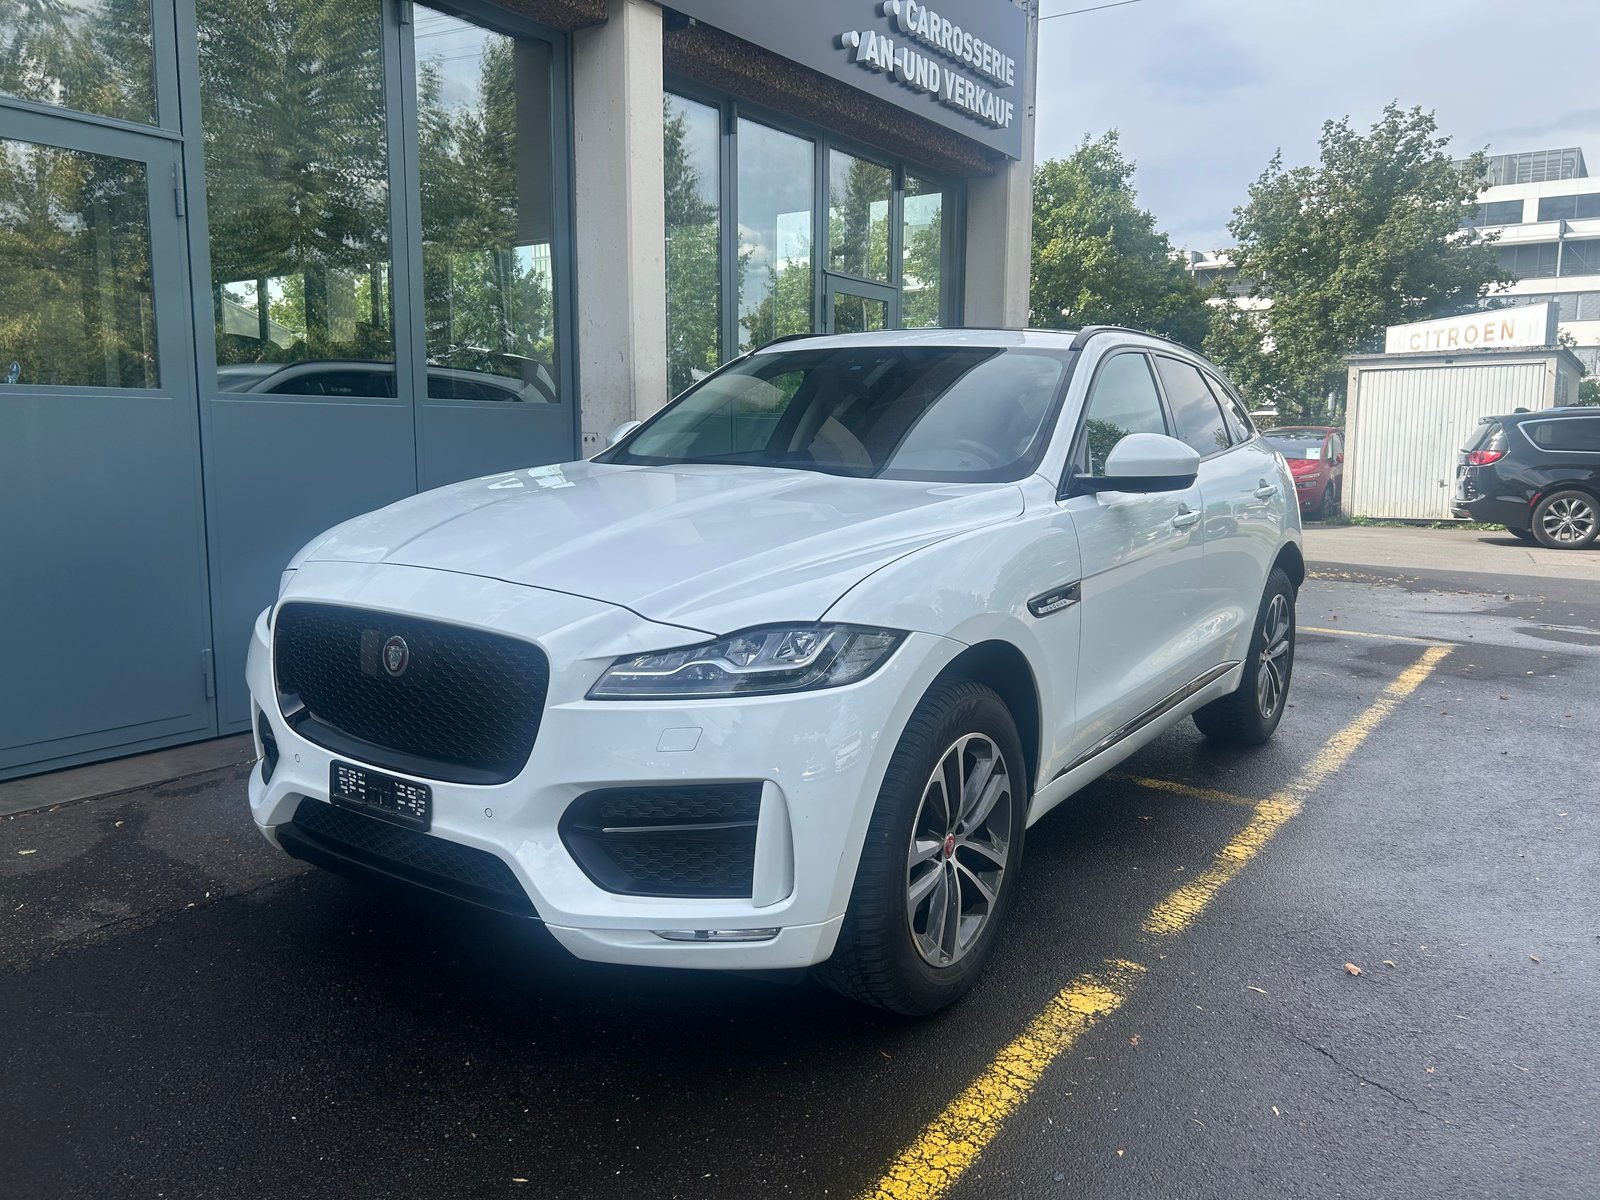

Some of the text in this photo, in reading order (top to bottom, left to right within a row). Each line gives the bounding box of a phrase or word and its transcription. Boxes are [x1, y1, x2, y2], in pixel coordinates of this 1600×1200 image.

[857, 30, 1015, 129] AN-UND VERKAUF
[899, 0, 1015, 87] CARROSSERIE
[1409, 320, 1515, 351] CITROEN
